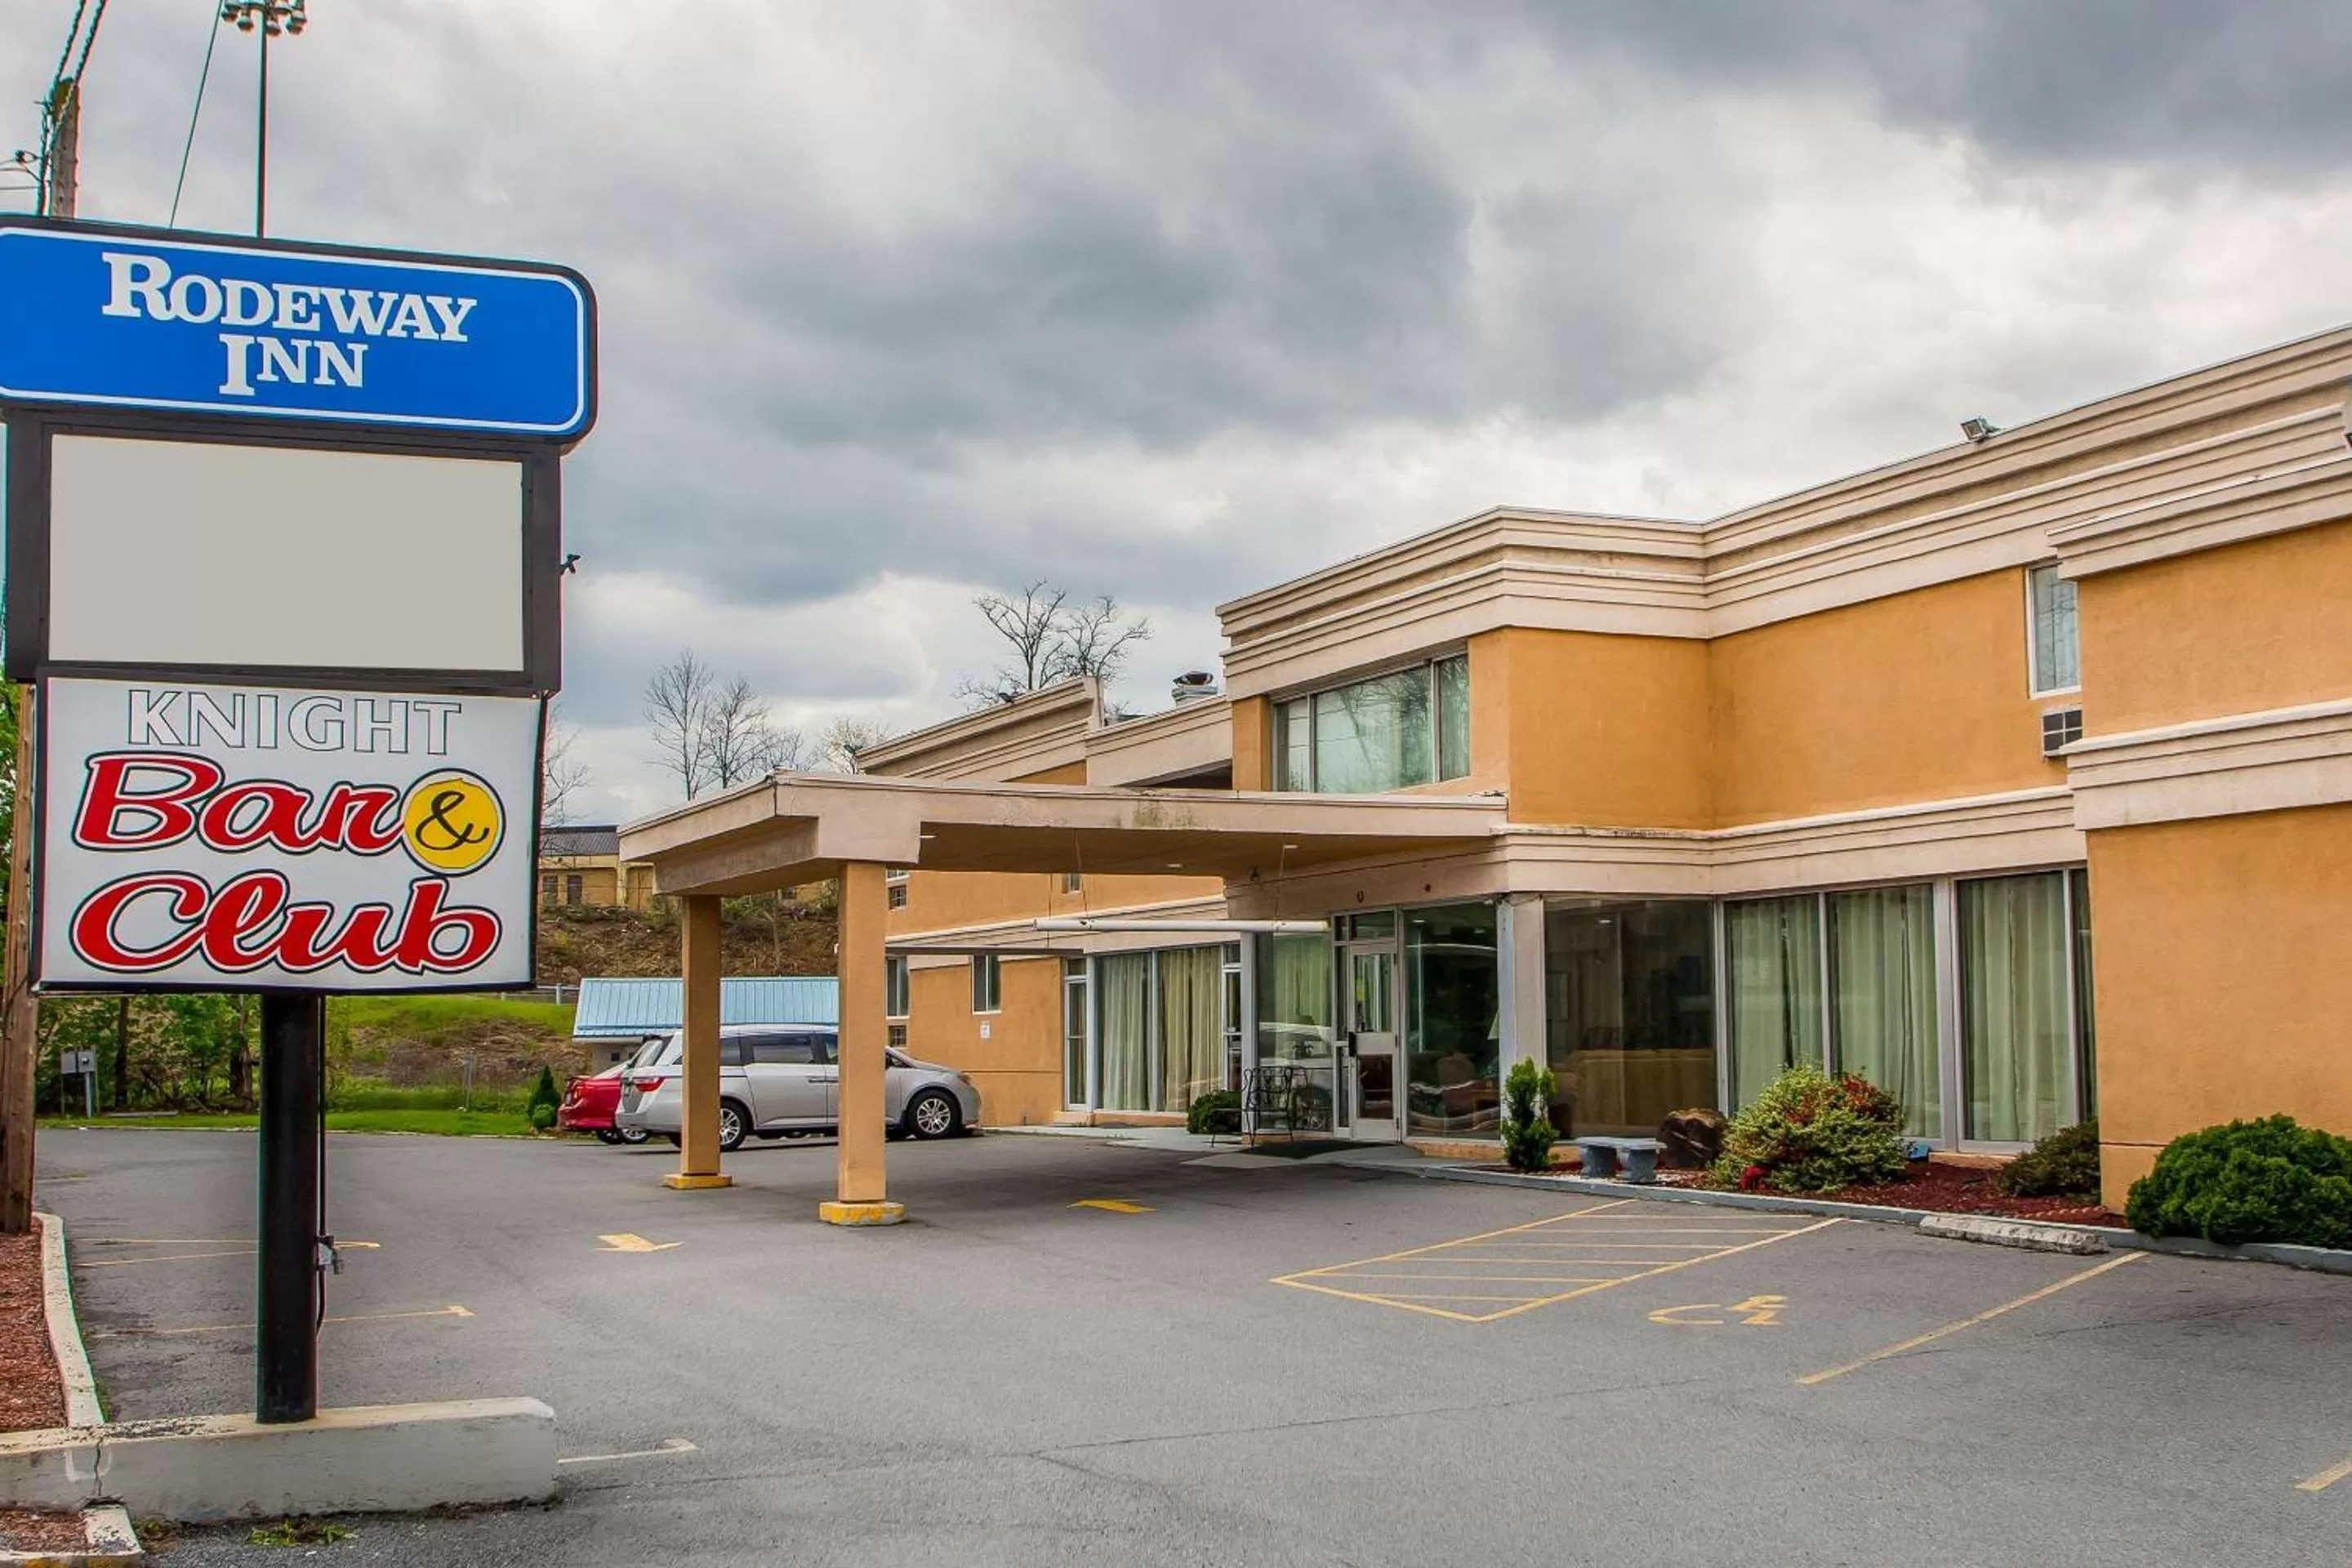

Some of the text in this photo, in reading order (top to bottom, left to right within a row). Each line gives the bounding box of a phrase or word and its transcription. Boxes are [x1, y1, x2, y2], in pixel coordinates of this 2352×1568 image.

[101, 252, 477, 342] RODEWAY
[219, 333, 368, 396] INN
[127, 689, 462, 755] KNIGHT
[72, 751, 407, 855] Bar
[69, 869, 502, 975] Club
